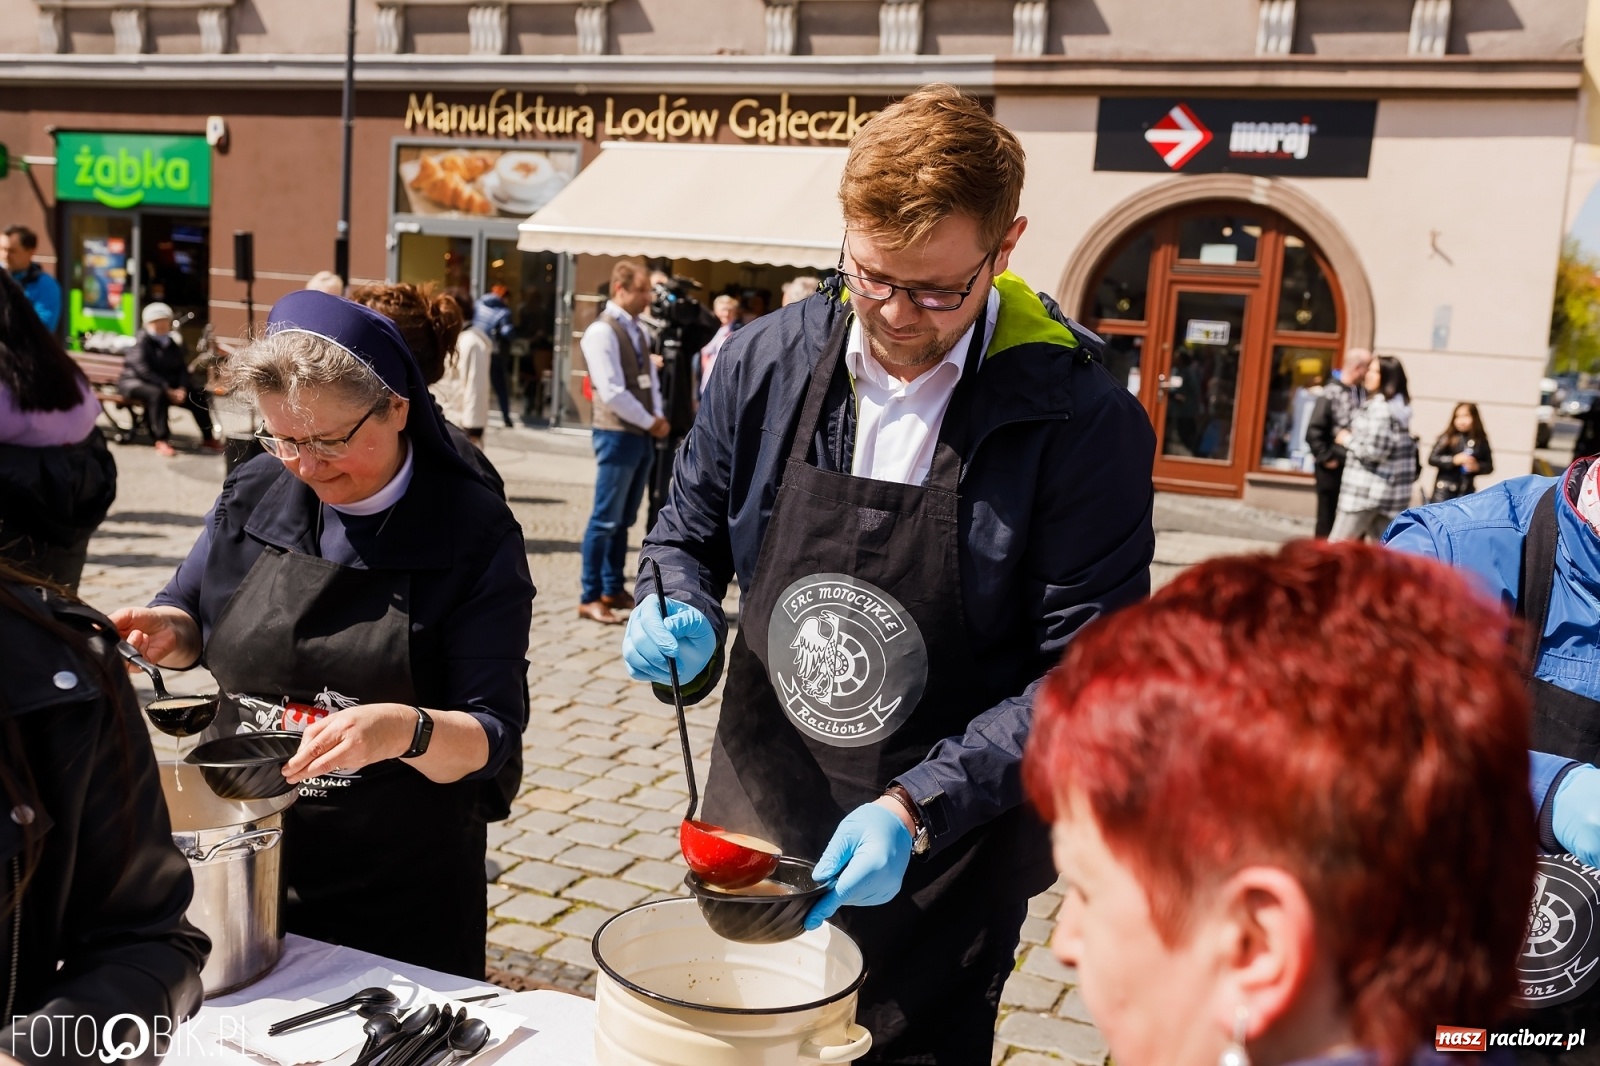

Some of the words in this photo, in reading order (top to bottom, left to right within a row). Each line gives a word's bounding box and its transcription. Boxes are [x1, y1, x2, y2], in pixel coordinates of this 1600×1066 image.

[404, 88, 594, 138] Manufaktura
[604, 94, 719, 141] Lodów
[728, 91, 882, 142] Gałeczk
[1229, 116, 1310, 159] moraj
[74, 144, 190, 190] żabka
[790, 590, 814, 613] SRC
[819, 587, 898, 632] MOTOCYKLE
